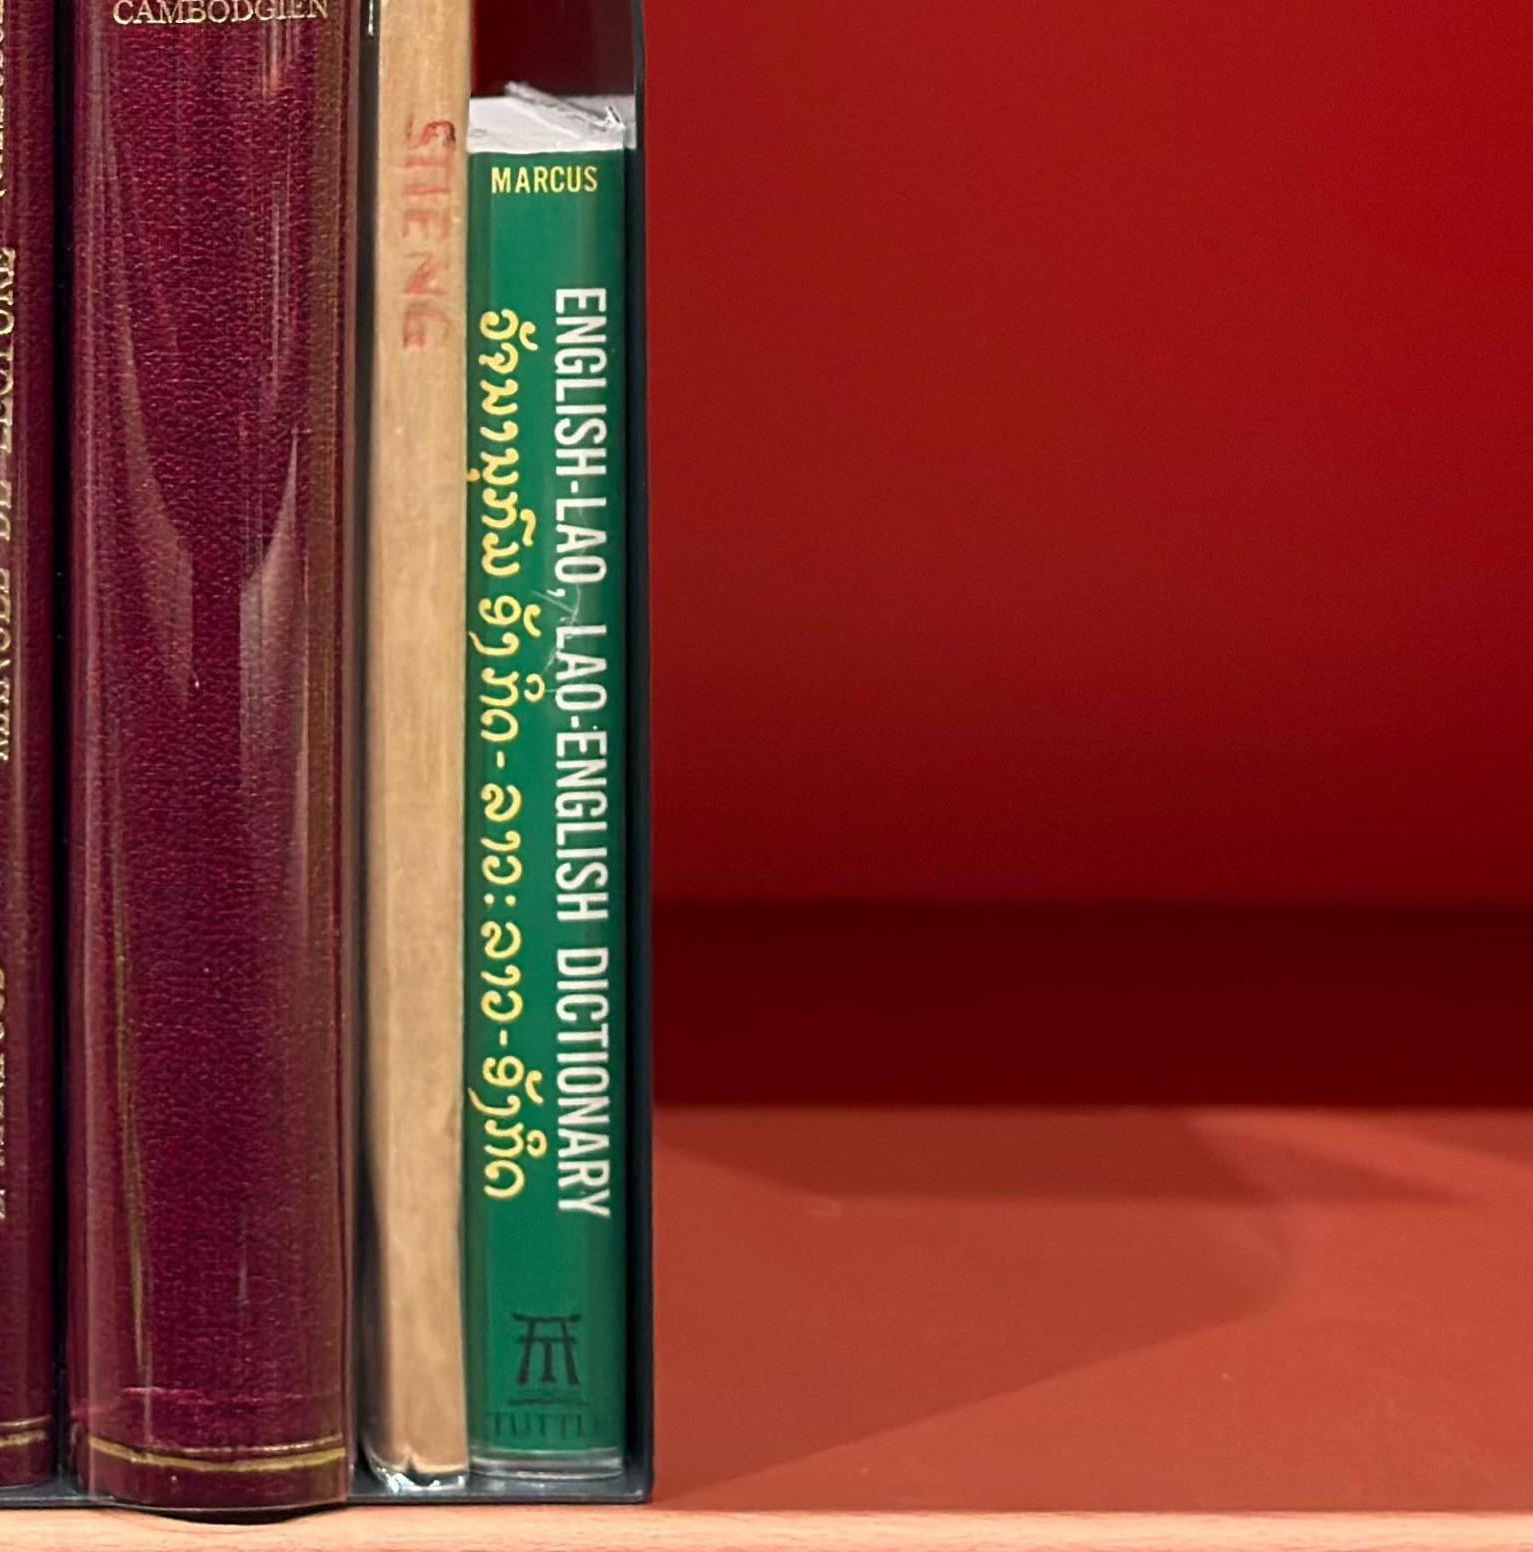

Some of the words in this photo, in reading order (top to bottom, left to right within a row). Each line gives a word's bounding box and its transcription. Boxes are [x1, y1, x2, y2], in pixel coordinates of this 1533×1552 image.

[490, 165, 599, 195] MARCUS
[547, 286, 608, 599] ENGLISH-LAO,
[554, 624, 610, 921] LAO-ENGLISH
[555, 948, 612, 1219] DICTIONARY
